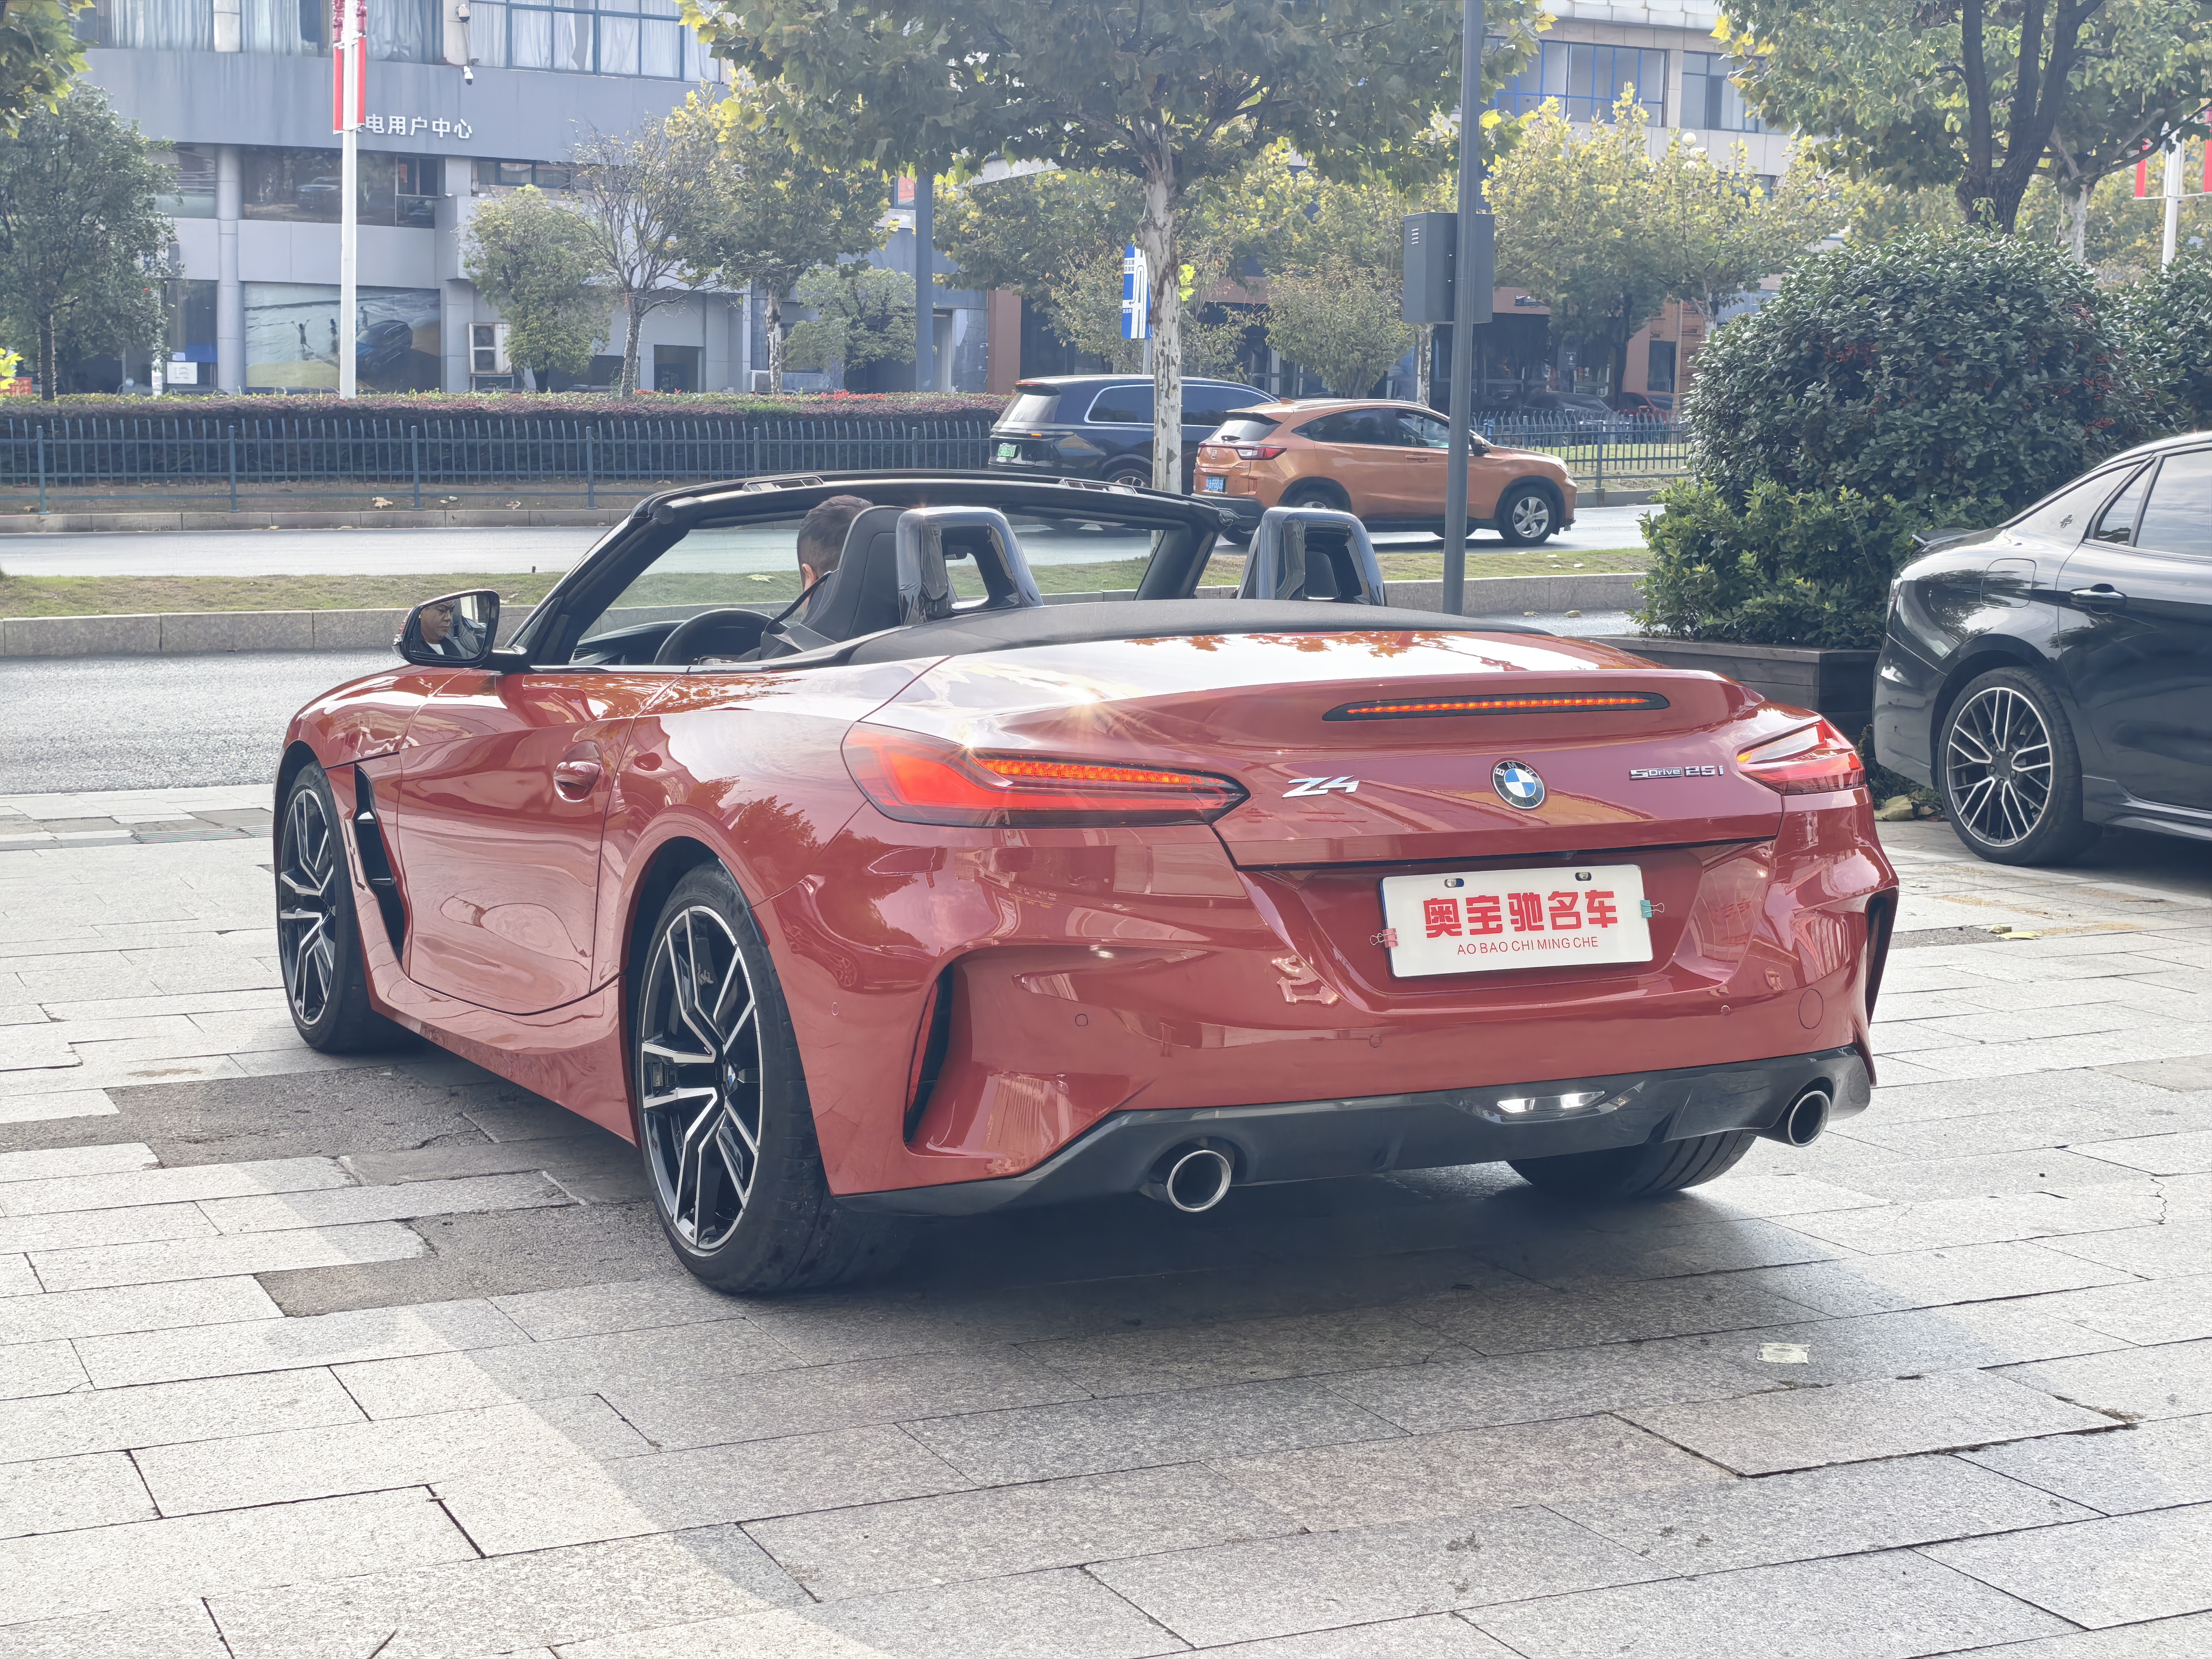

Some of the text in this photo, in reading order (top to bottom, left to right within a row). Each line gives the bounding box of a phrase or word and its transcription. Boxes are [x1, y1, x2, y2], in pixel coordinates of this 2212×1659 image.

[355, 114, 473, 139] 电用户中心
[1495, 761, 1534, 777] BMW
[1282, 775, 1360, 798] Z4
[1423, 889, 1618, 939] 奥宝驰名车
[1457, 936, 1599, 955] AO BAO CHI MING CHE
